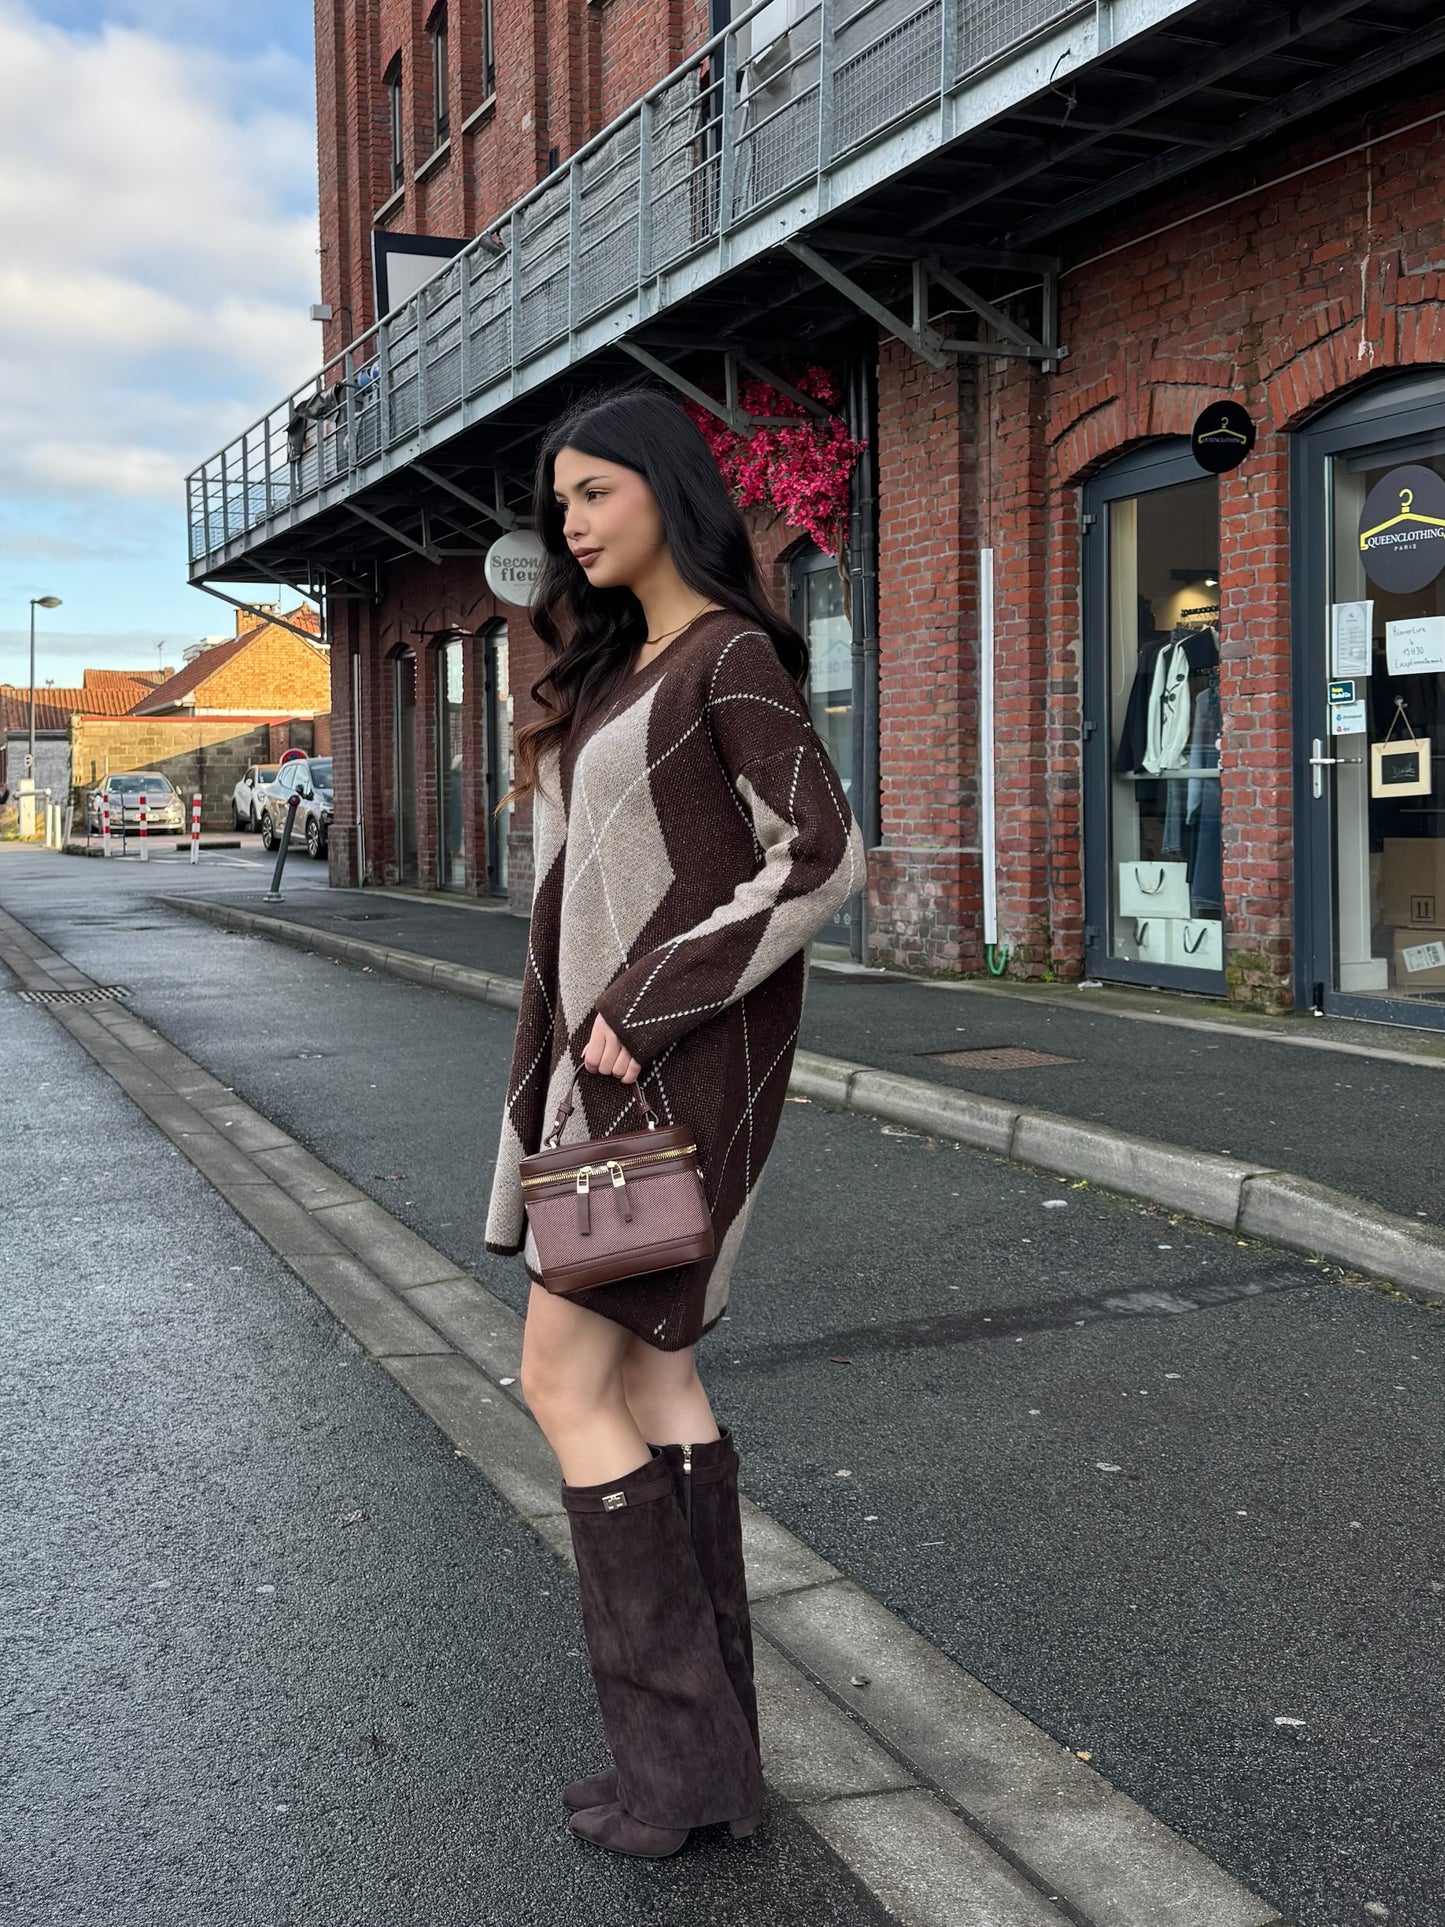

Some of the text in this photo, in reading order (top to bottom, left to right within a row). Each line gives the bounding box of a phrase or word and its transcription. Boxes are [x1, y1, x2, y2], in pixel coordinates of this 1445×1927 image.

[1367, 528, 1444, 548] QUEENCLOTHING
[492, 555, 541, 568] Secon
[501, 568, 536, 581] fleu
